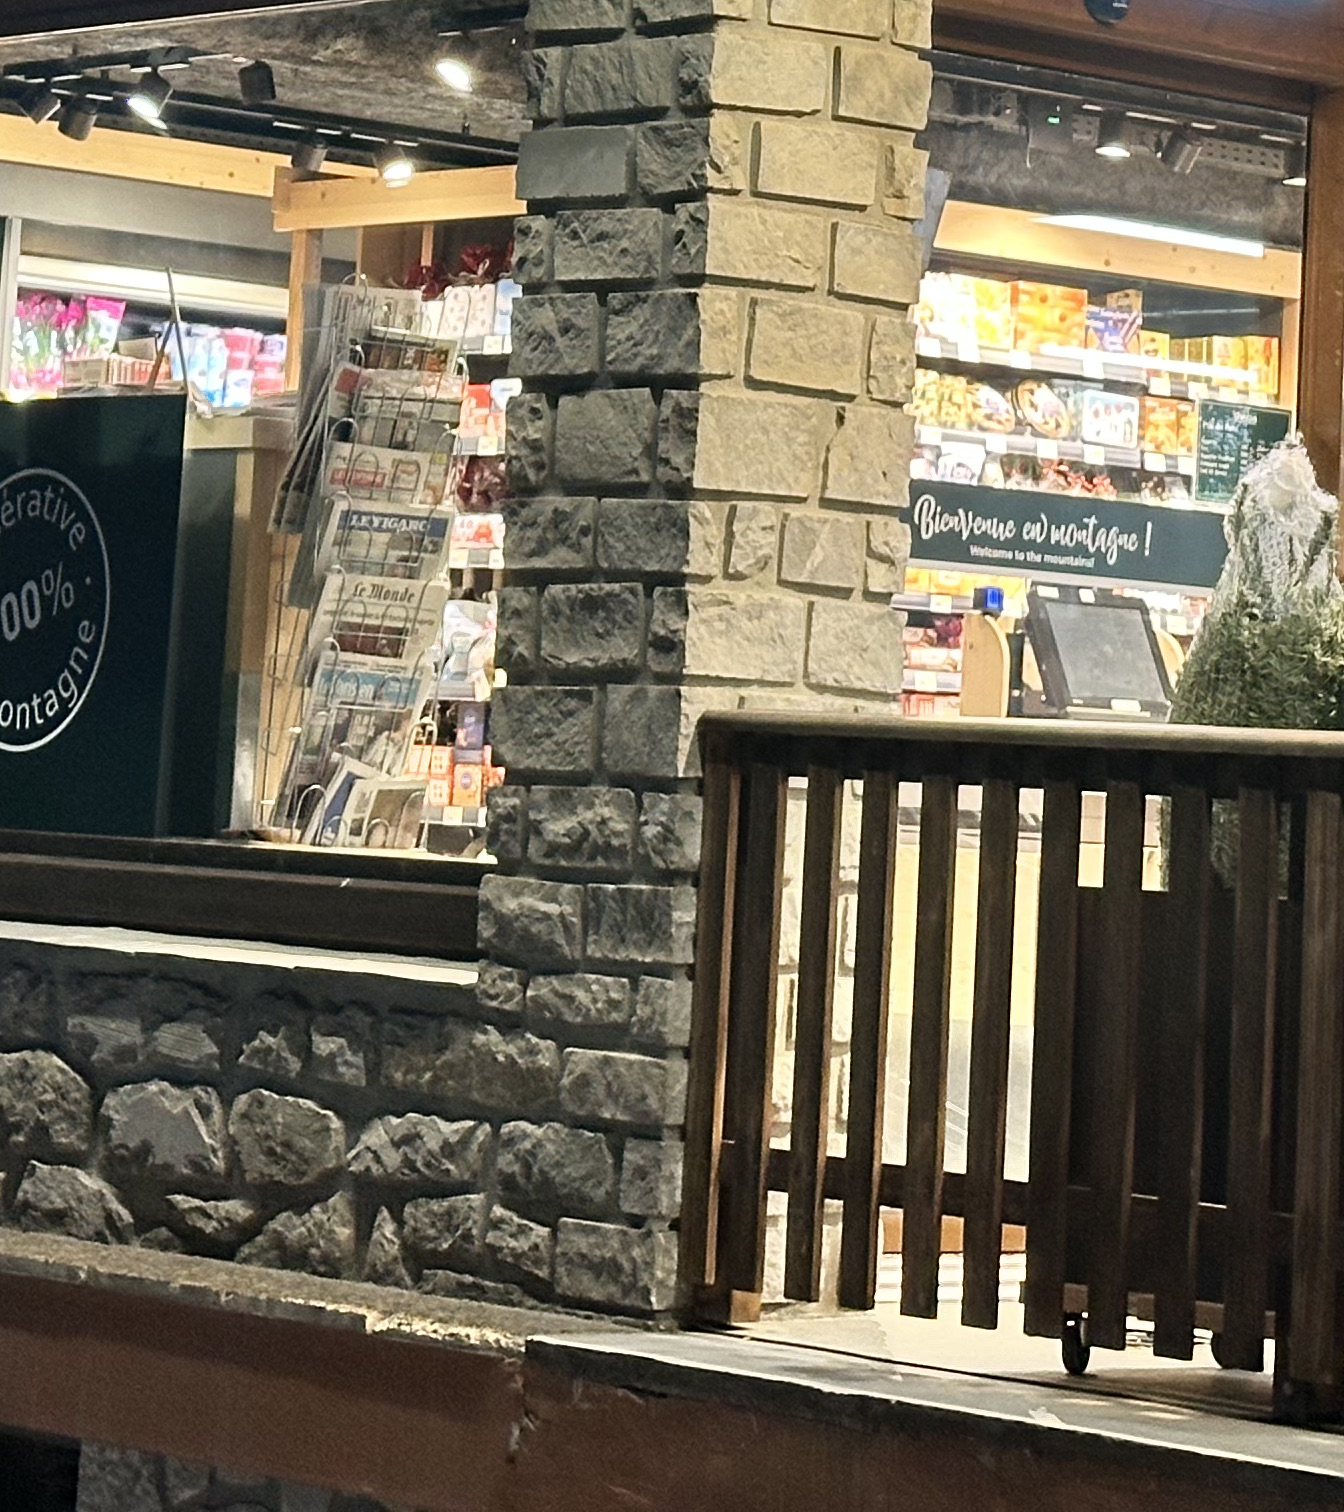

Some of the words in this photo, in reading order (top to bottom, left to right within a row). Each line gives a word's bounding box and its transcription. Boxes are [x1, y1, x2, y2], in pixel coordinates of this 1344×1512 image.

[913, 493, 1017, 541] Bienvenue
[1022, 511, 1048, 544] en
[1049, 513, 1139, 566] montagne
[969, 544, 1014, 560] Welcome
[1014, 550, 1025, 561] to
[1026, 550, 1043, 563] the
[352, 580, 367, 598] Le
[368, 582, 416, 604] Monde
